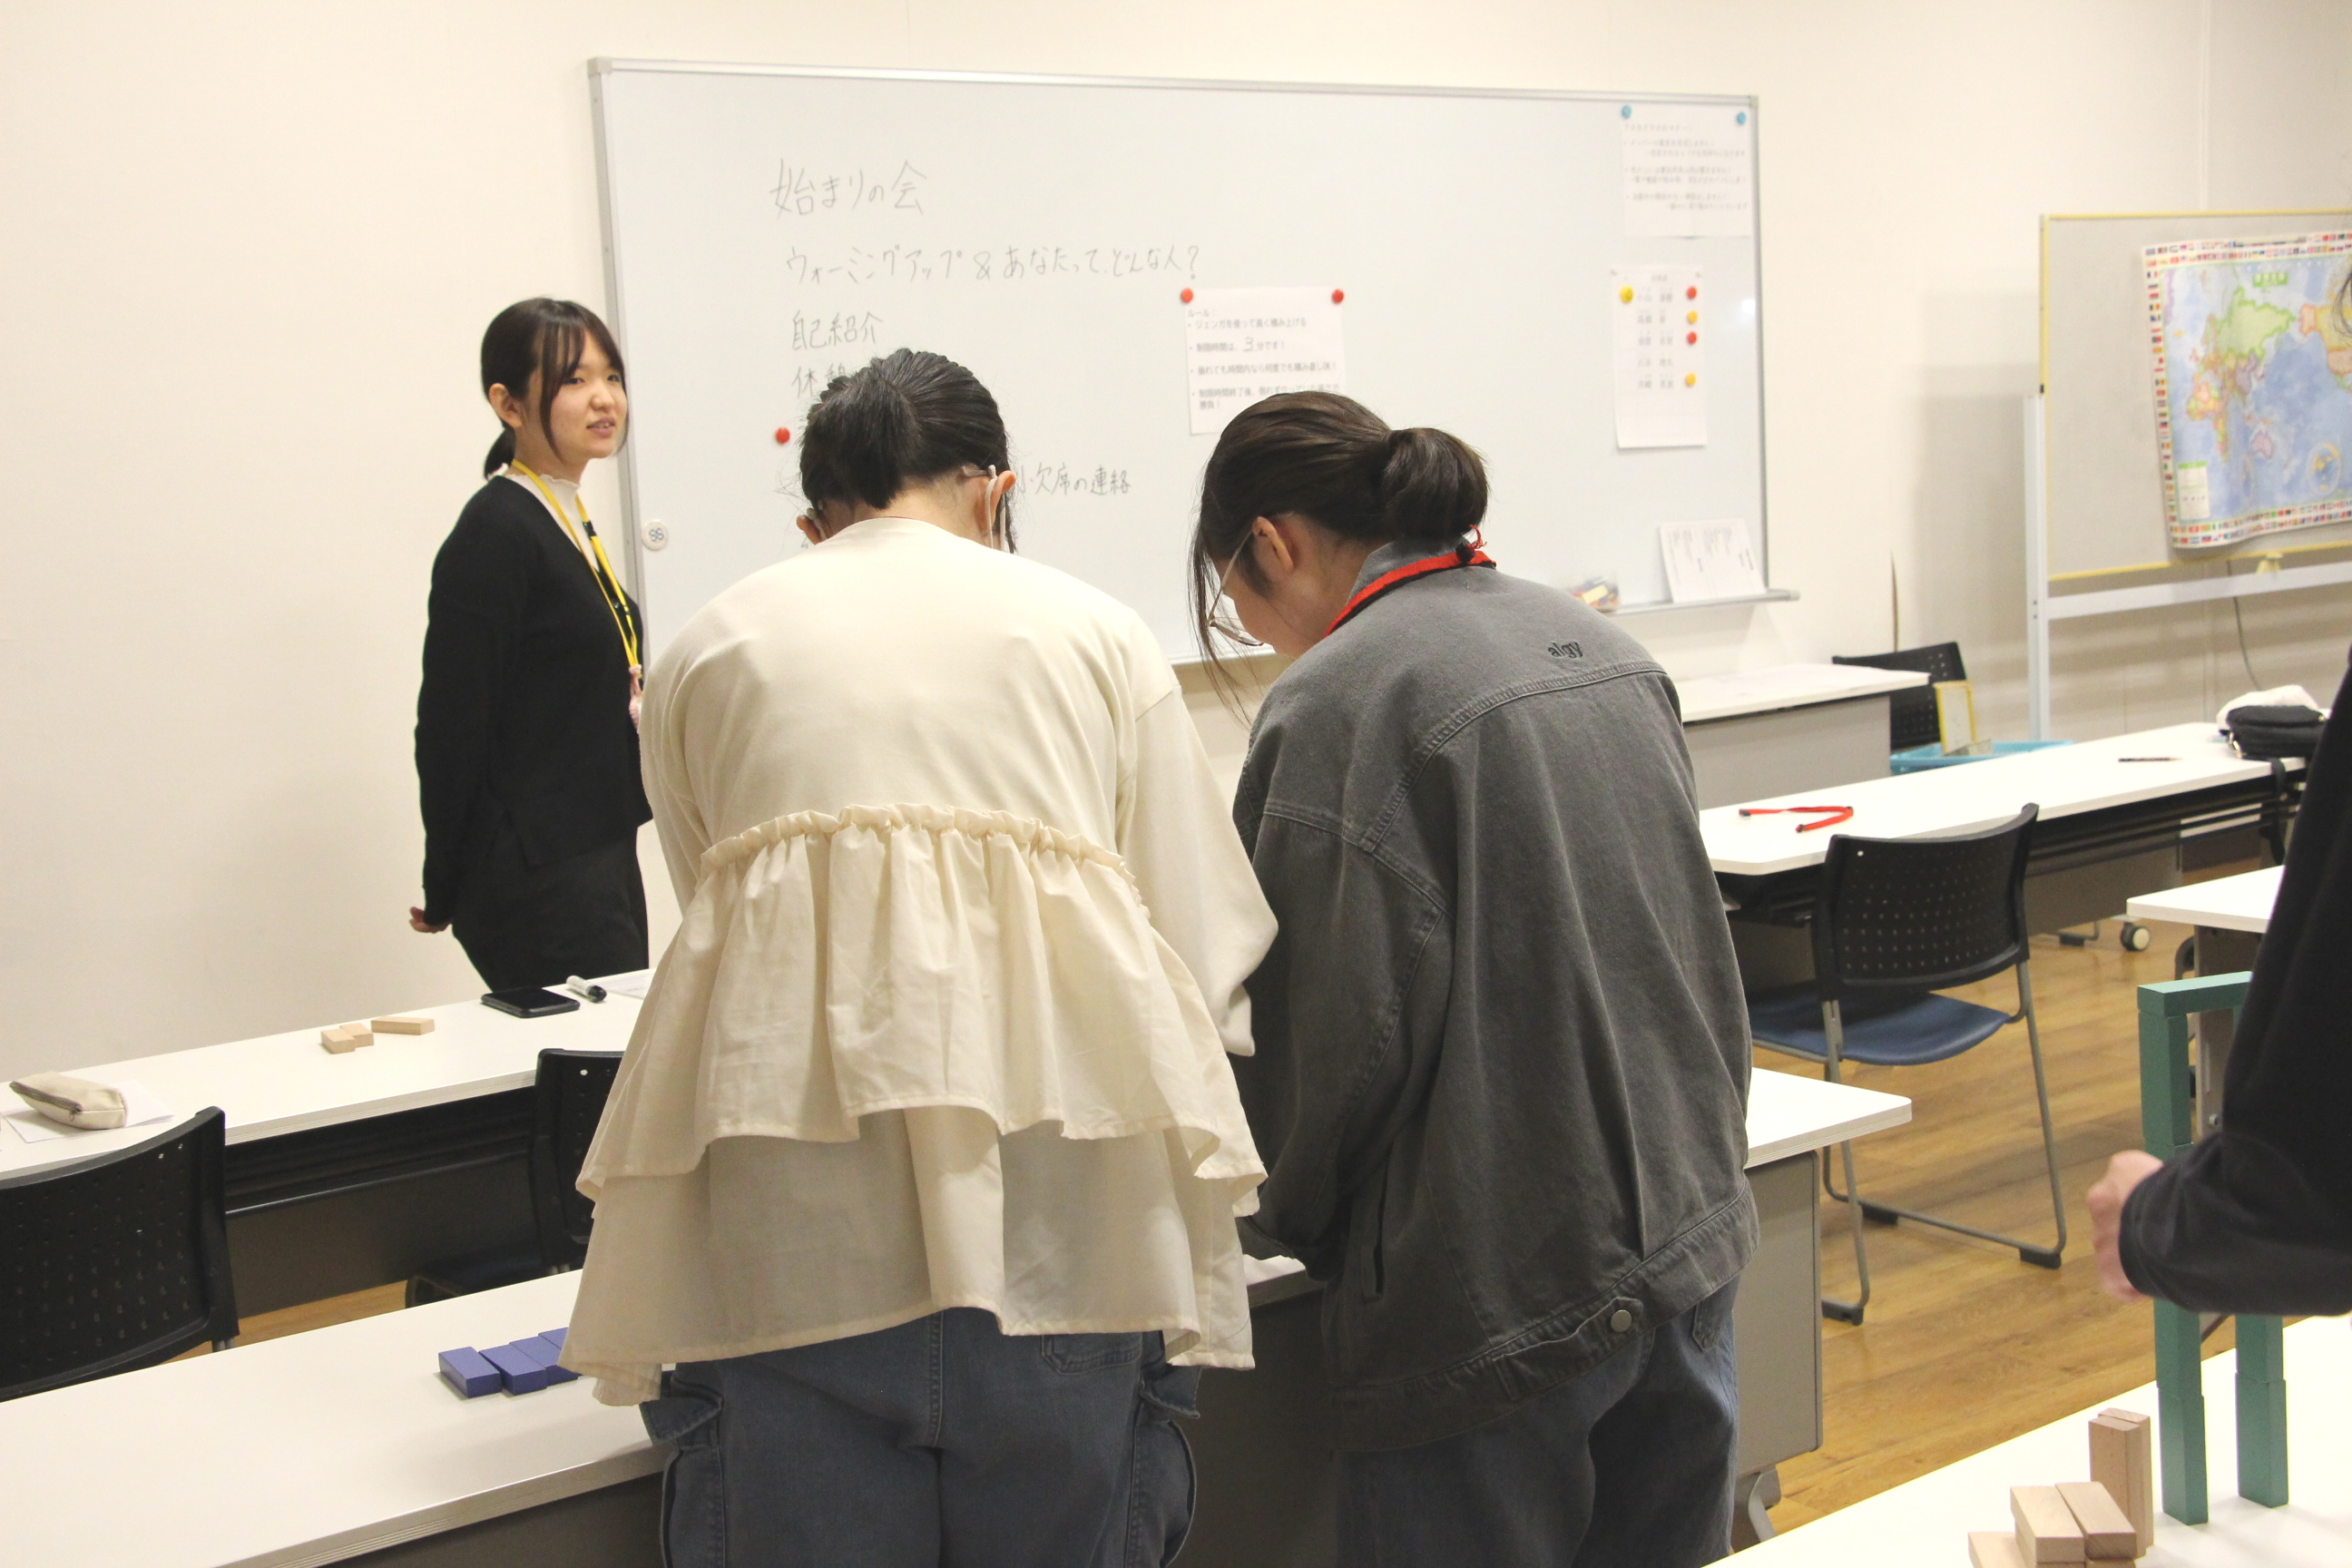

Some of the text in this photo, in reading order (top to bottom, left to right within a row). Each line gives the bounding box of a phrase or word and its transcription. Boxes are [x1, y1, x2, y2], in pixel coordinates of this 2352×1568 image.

[769, 157, 928, 220] 始まりの会
[786, 245, 963, 285] ウォーミングアップ
[973, 250, 991, 280] &
[791, 309, 884, 351] 自己紹介
[1548, 642, 1583, 659] algy
